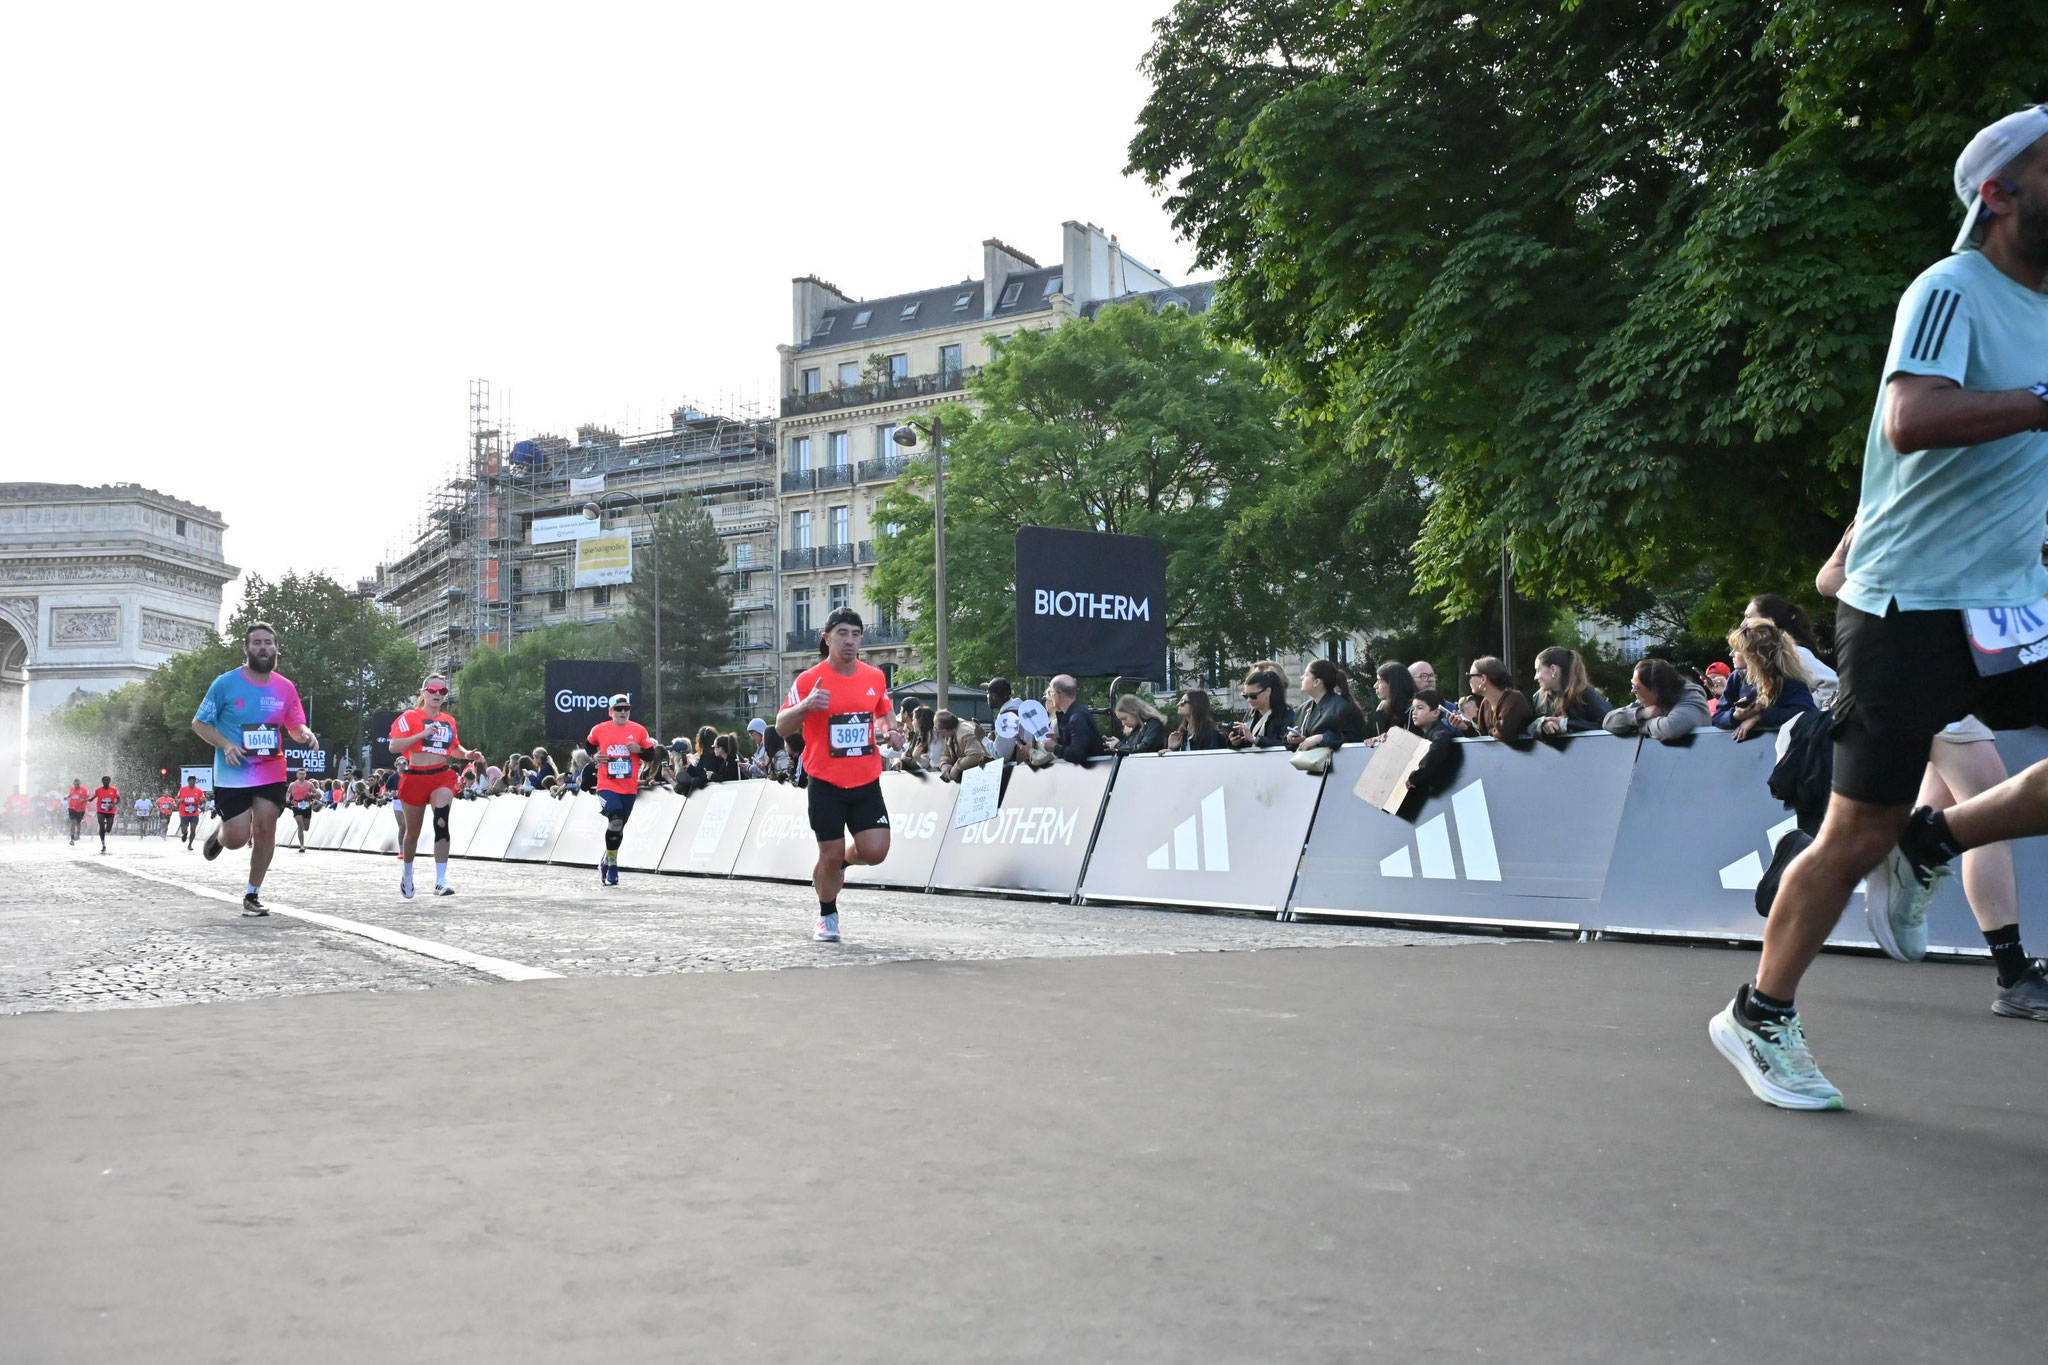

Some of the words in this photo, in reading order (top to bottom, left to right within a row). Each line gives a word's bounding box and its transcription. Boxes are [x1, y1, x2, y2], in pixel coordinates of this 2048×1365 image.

[1034, 589, 1150, 622] BIOTHERM
[247, 734, 273, 746] 16146
[836, 727, 865, 744] 3892
[285, 749, 326, 759] POWER
[303, 758, 326, 768] ADE
[1747, 1038, 1772, 1075] HOKA
